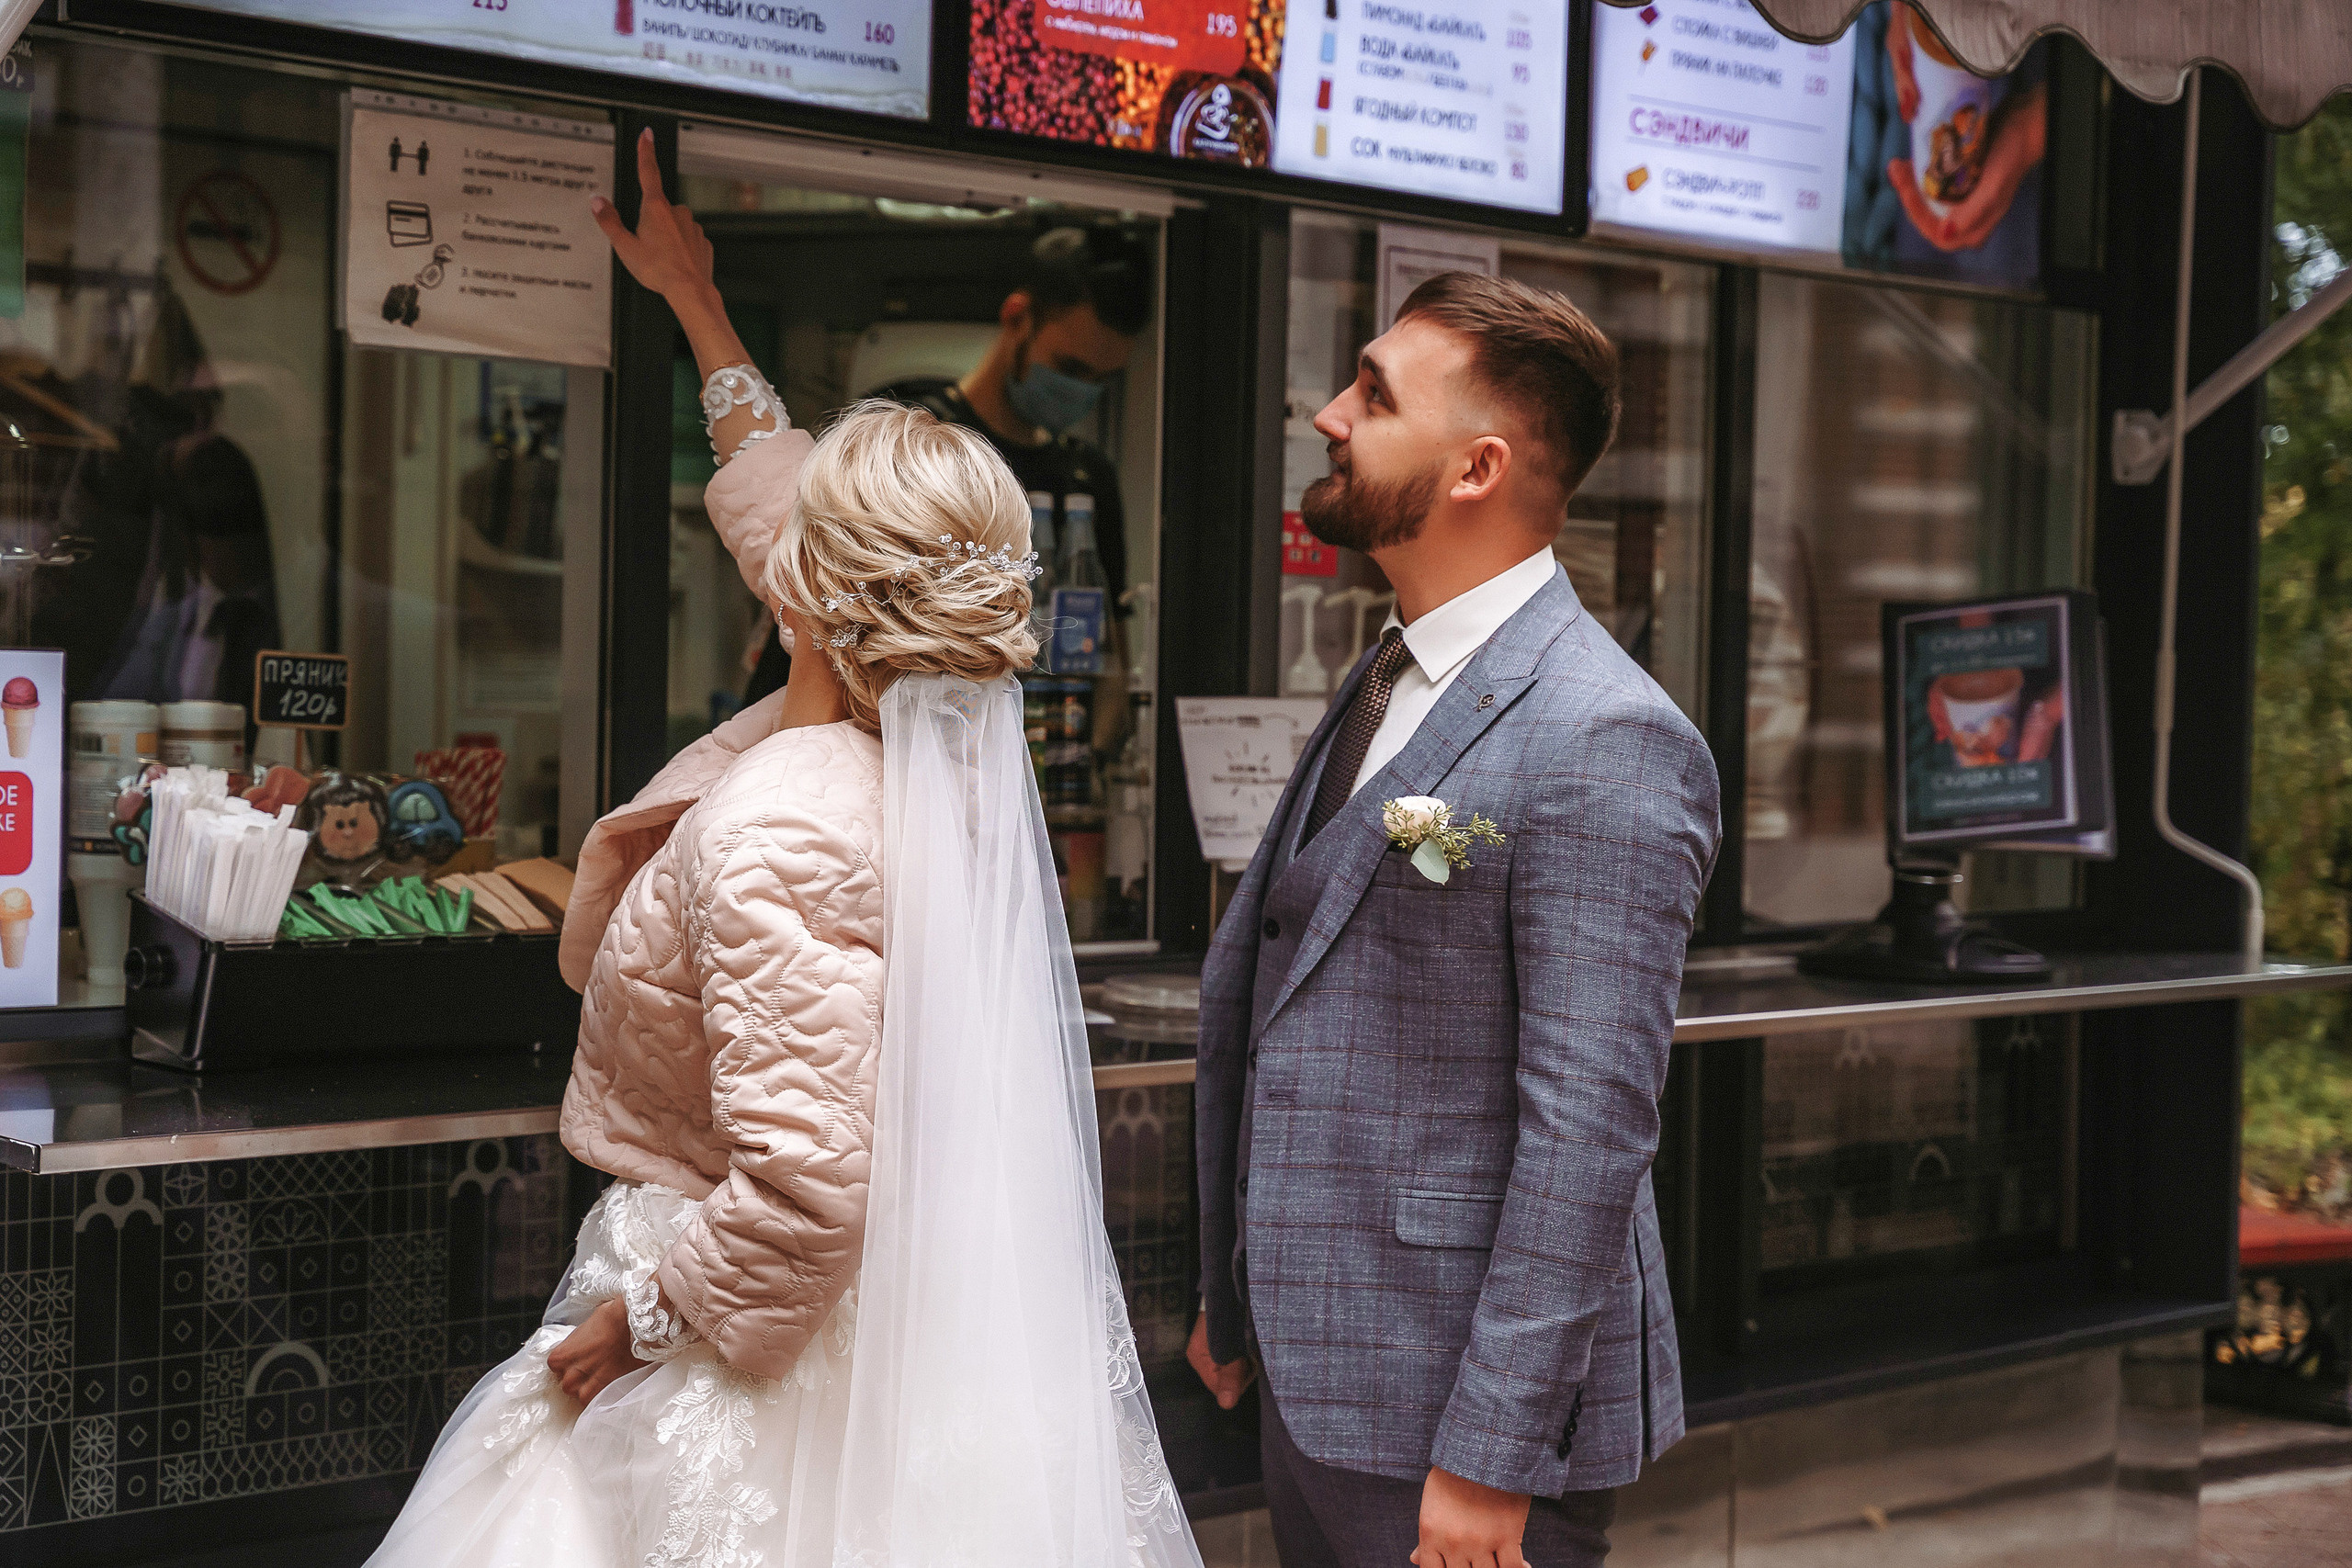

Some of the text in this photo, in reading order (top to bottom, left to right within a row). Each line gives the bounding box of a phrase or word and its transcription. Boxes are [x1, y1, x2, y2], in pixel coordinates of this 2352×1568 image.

[642, 0, 896, 45] ОЛОЧНЫЙ КОКТЕЙЛЬ 160
[1206, 12, 1237, 38] 195
[1629, 107, 1749, 151] СЭНДВИЧИ
